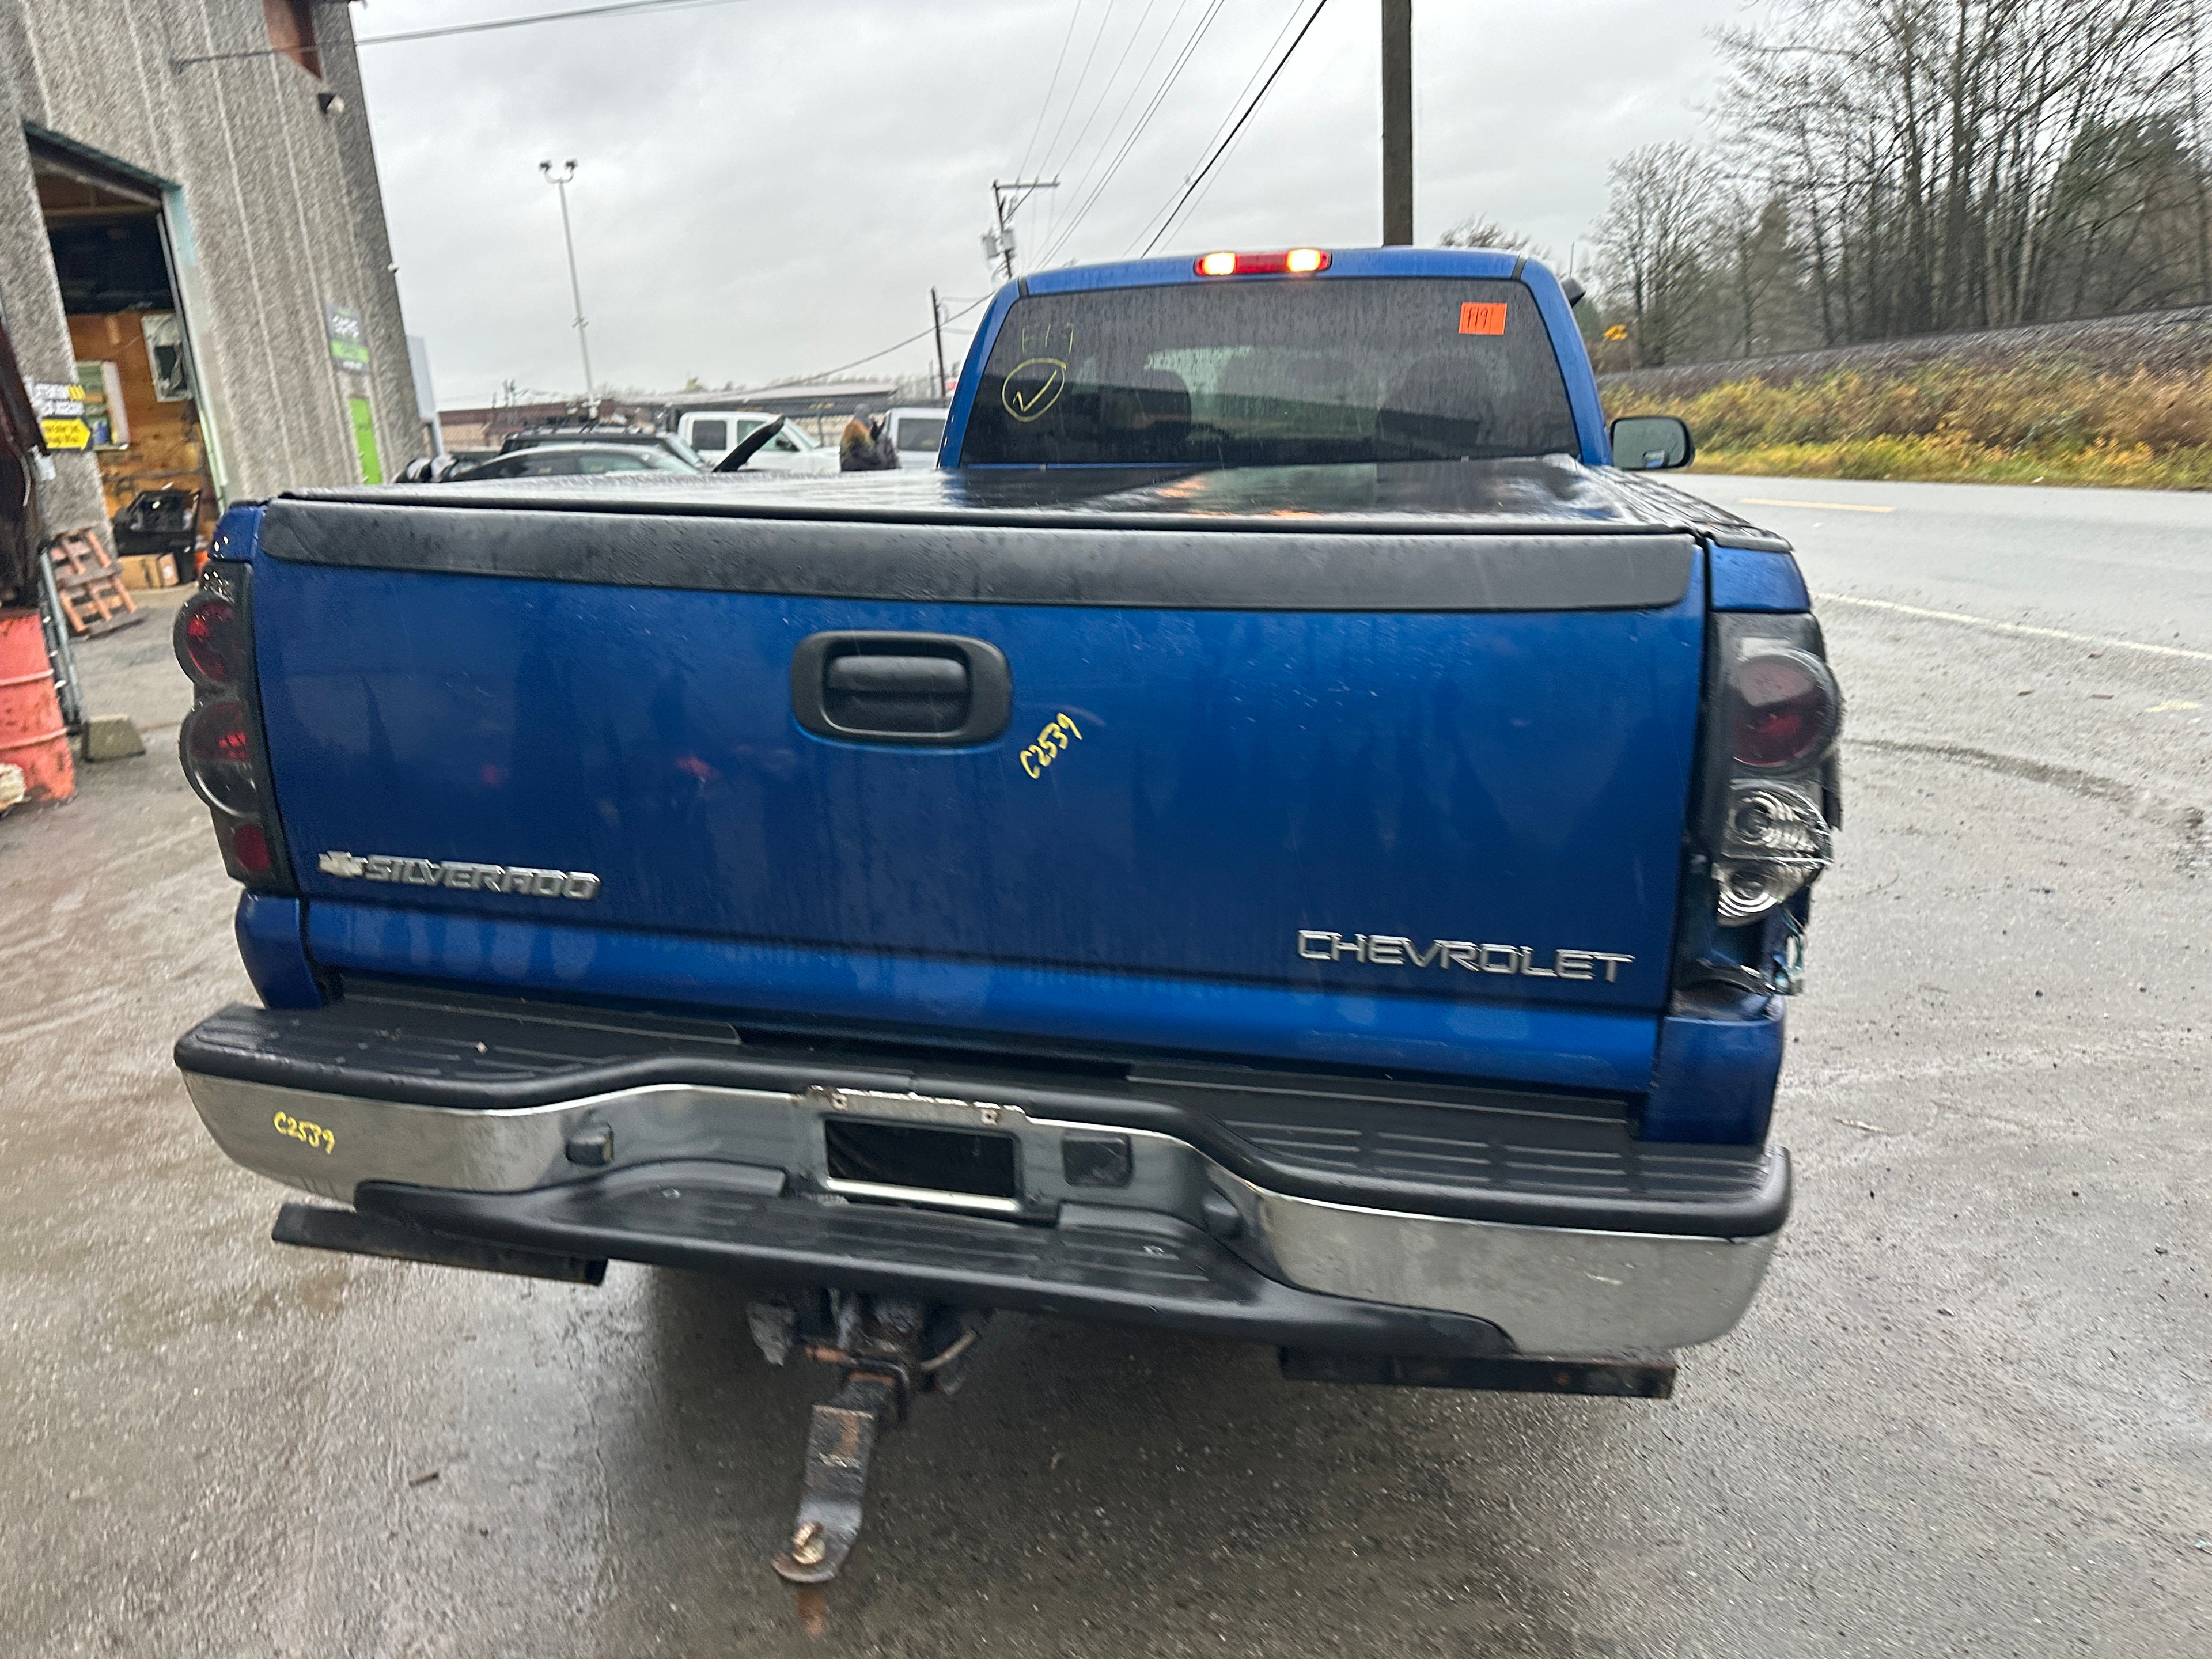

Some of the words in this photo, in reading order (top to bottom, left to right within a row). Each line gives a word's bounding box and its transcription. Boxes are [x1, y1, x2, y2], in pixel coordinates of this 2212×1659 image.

[1019, 712, 1082, 779] C2539
[365, 854, 600, 899] SILVERADO
[1297, 929, 1635, 983] CHEVROLET
[274, 1111, 336, 1155] C2539
